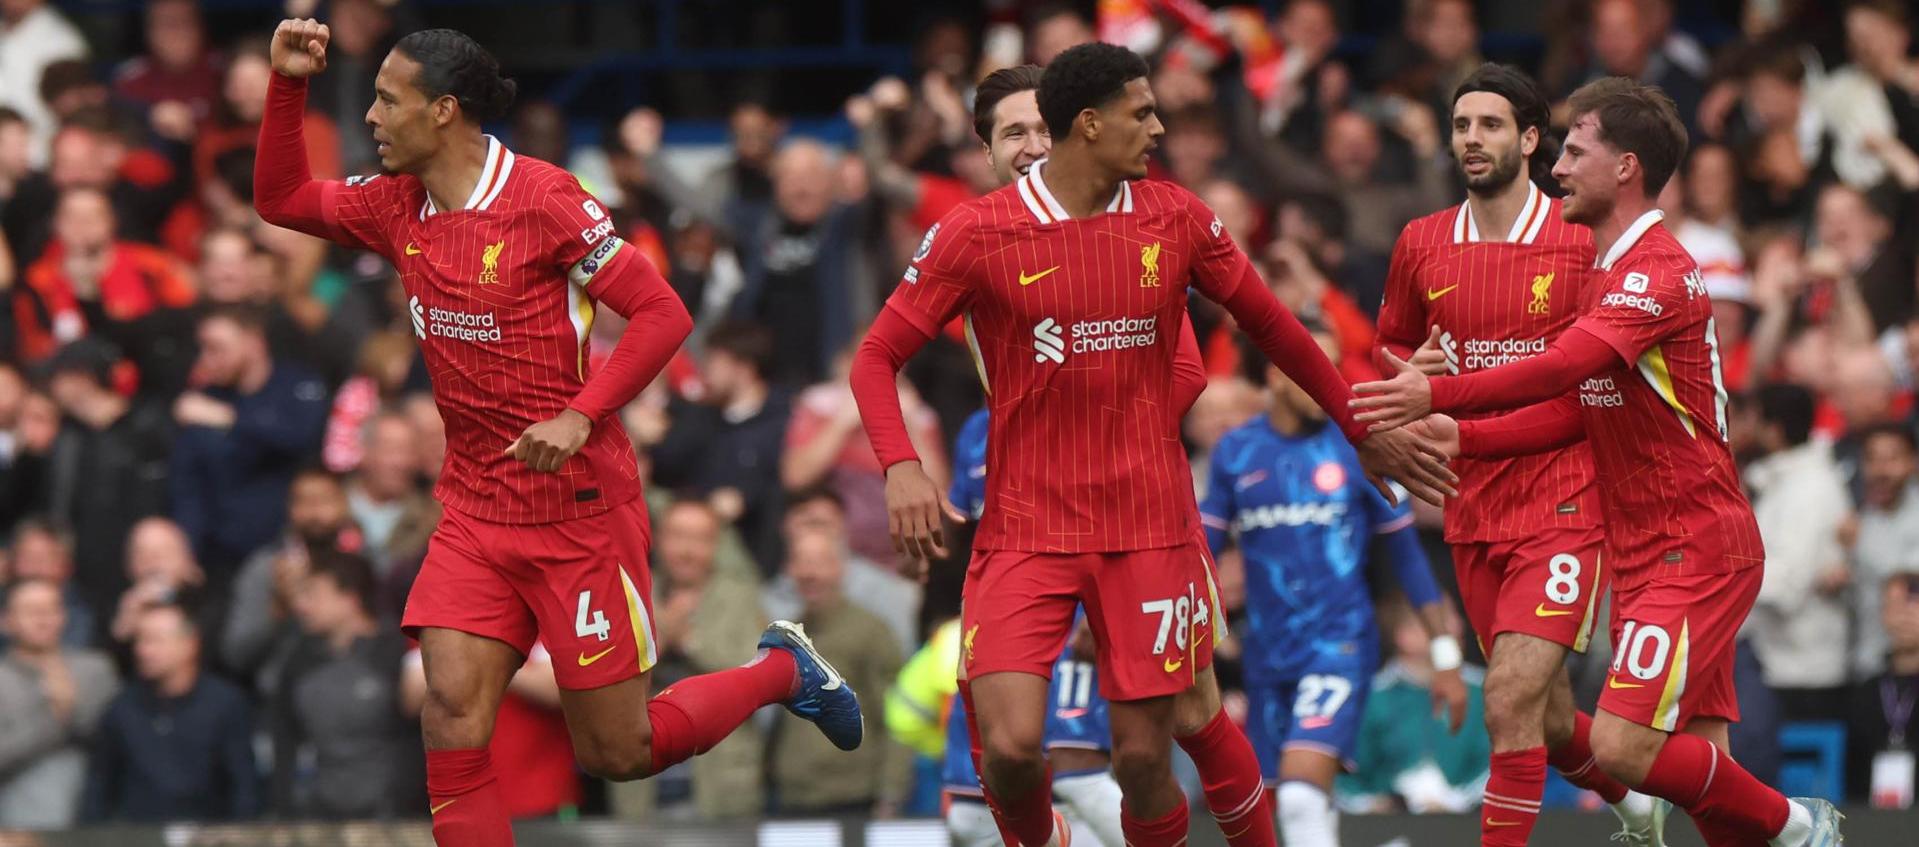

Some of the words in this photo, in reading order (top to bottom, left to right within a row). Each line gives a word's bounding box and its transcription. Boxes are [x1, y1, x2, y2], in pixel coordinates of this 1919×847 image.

[429, 306, 495, 328] standard
[430, 322, 501, 342] chartered
[1072, 315, 1157, 337] standard
[1072, 331, 1156, 354] chartered
[1464, 337, 1545, 354] standard
[1465, 352, 1537, 369] charte
[1545, 553, 1581, 605] 8
[575, 590, 611, 642] 4
[1142, 596, 1190, 655] 78
[1613, 620, 1671, 681] 10
[1058, 661, 1093, 708] 11
[1293, 674, 1352, 718] 27
